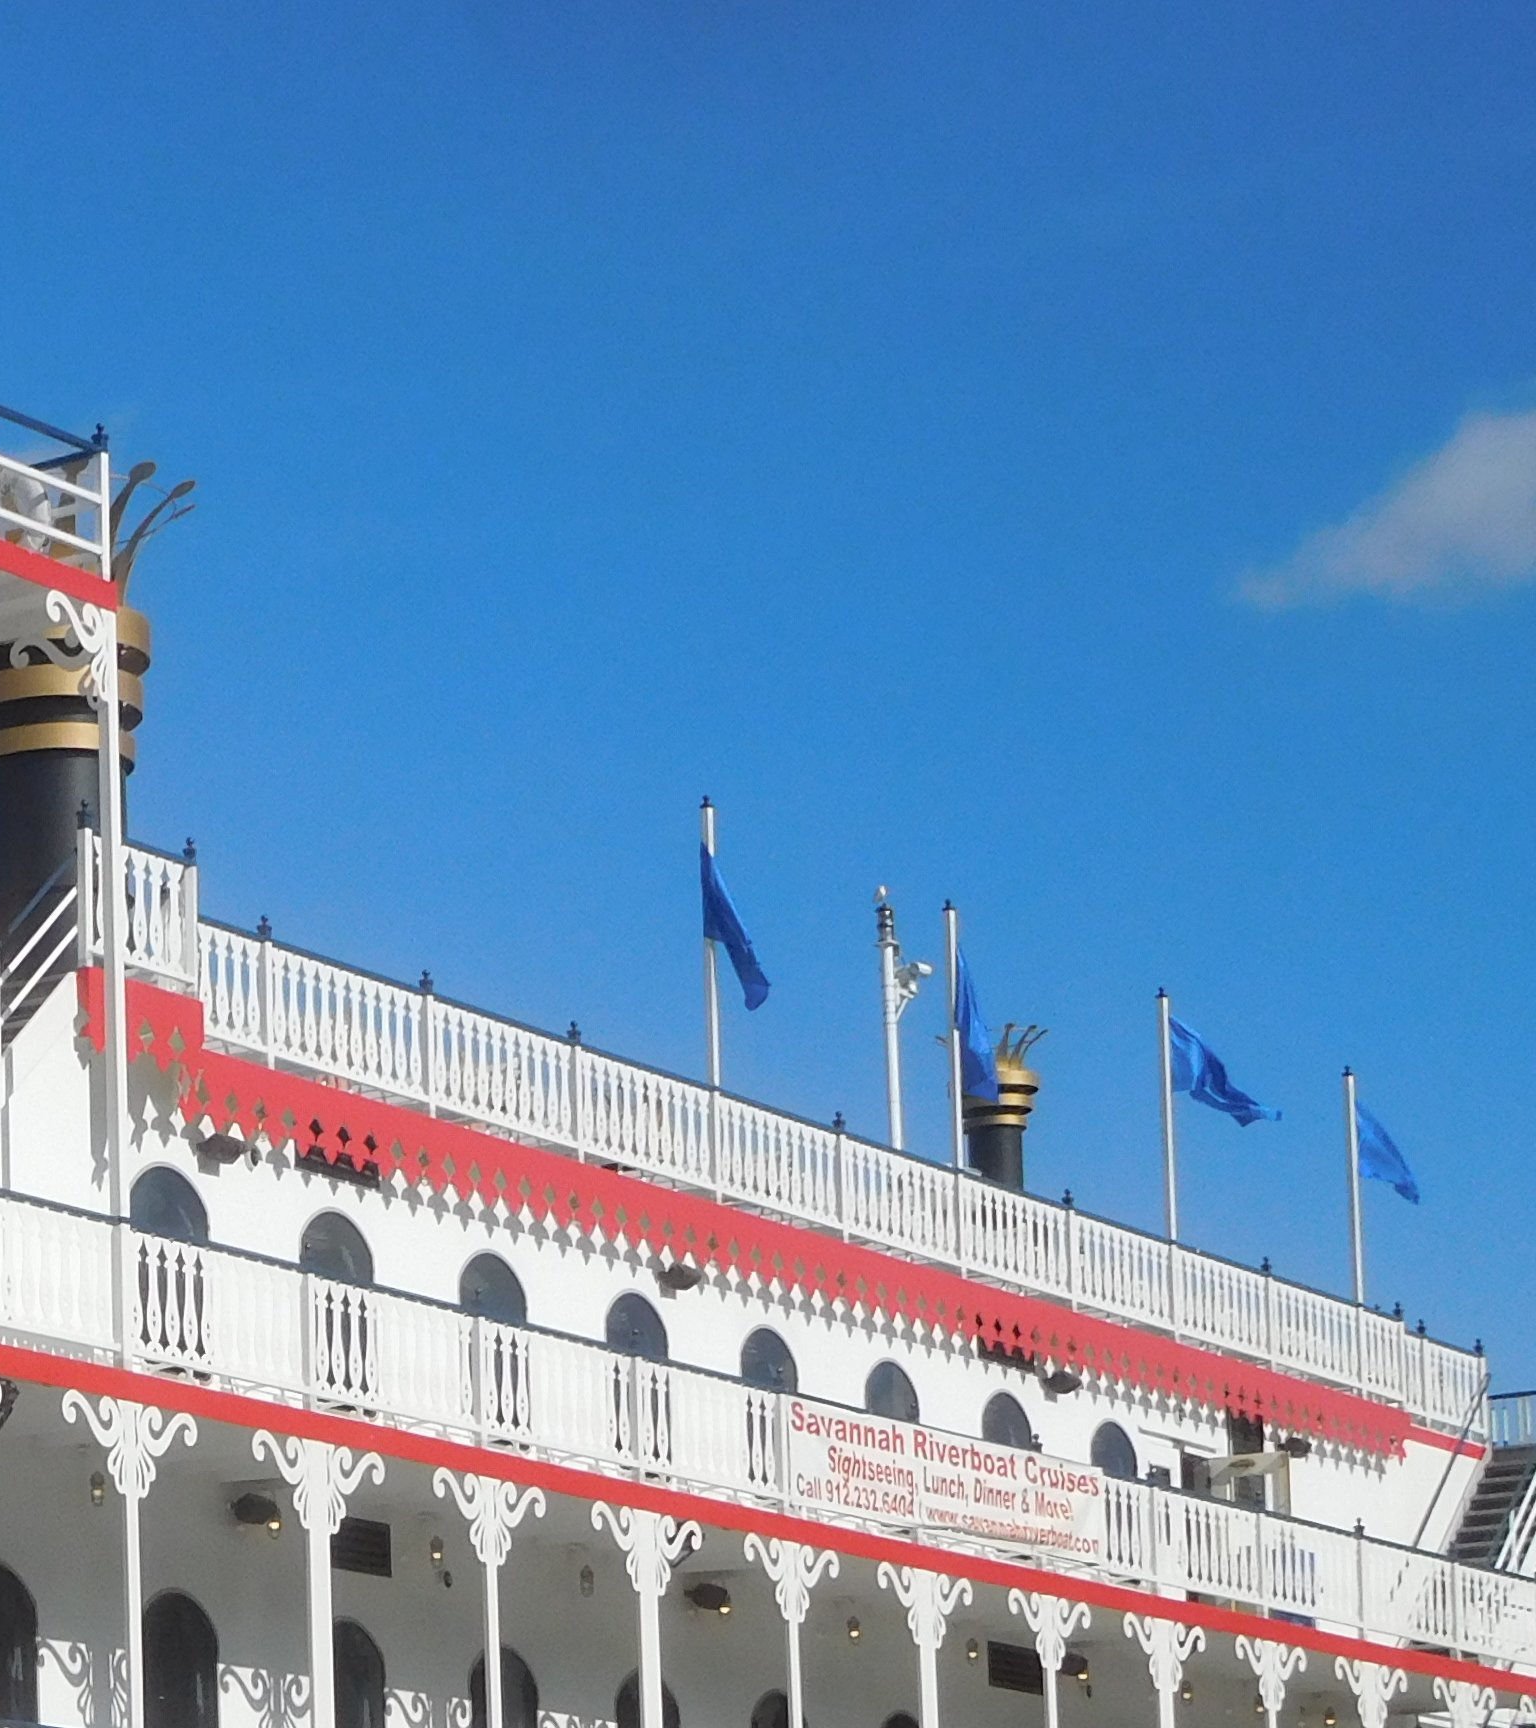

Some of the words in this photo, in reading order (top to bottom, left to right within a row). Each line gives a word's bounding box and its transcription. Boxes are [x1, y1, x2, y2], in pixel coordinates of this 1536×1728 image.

[790, 1401, 905, 1455] Savannah
[913, 1429, 1017, 1481] Riverboat
[1024, 1456, 1100, 1497] Cruises
[827, 1444, 919, 1497] Sightseeing,
[923, 1466, 969, 1507] Lunch,
[973, 1477, 1016, 1511] Dinner
[1021, 1487, 1030, 1514] &
[1034, 1490, 1075, 1521] More!
[796, 1472, 823, 1501] Call
[825, 1478, 915, 1519] 912.232.6404
